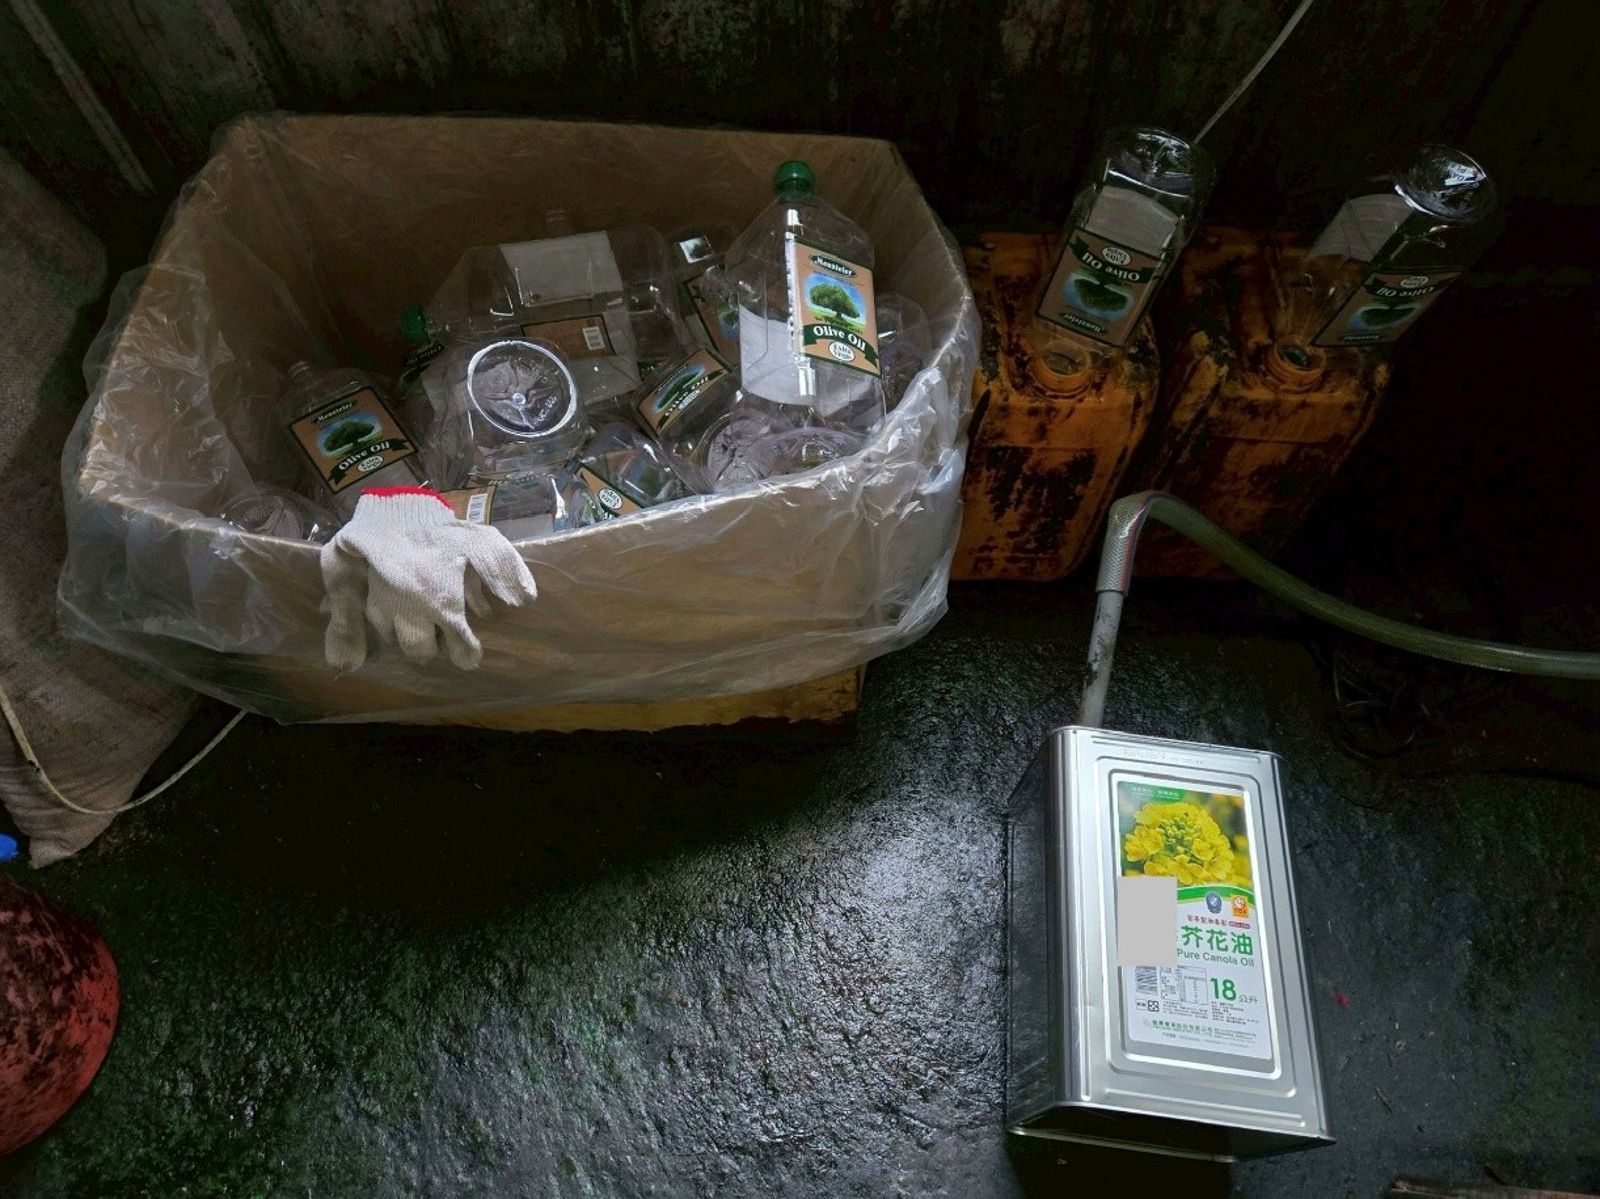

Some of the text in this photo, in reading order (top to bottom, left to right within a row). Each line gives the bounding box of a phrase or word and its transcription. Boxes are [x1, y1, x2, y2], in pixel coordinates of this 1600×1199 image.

[1081, 252, 1140, 282] Olive Oil
[1375, 286, 1434, 297] Olive Oil
[813, 325, 866, 351] Olive Oil
[339, 441, 390, 470] Olive Oil
[1180, 924, 1254, 956] 芥花油
[1177, 948, 1255, 967] Pure Canola Oil
[1210, 977, 1237, 1001] 18
[1239, 993, 1258, 1004] 公升
